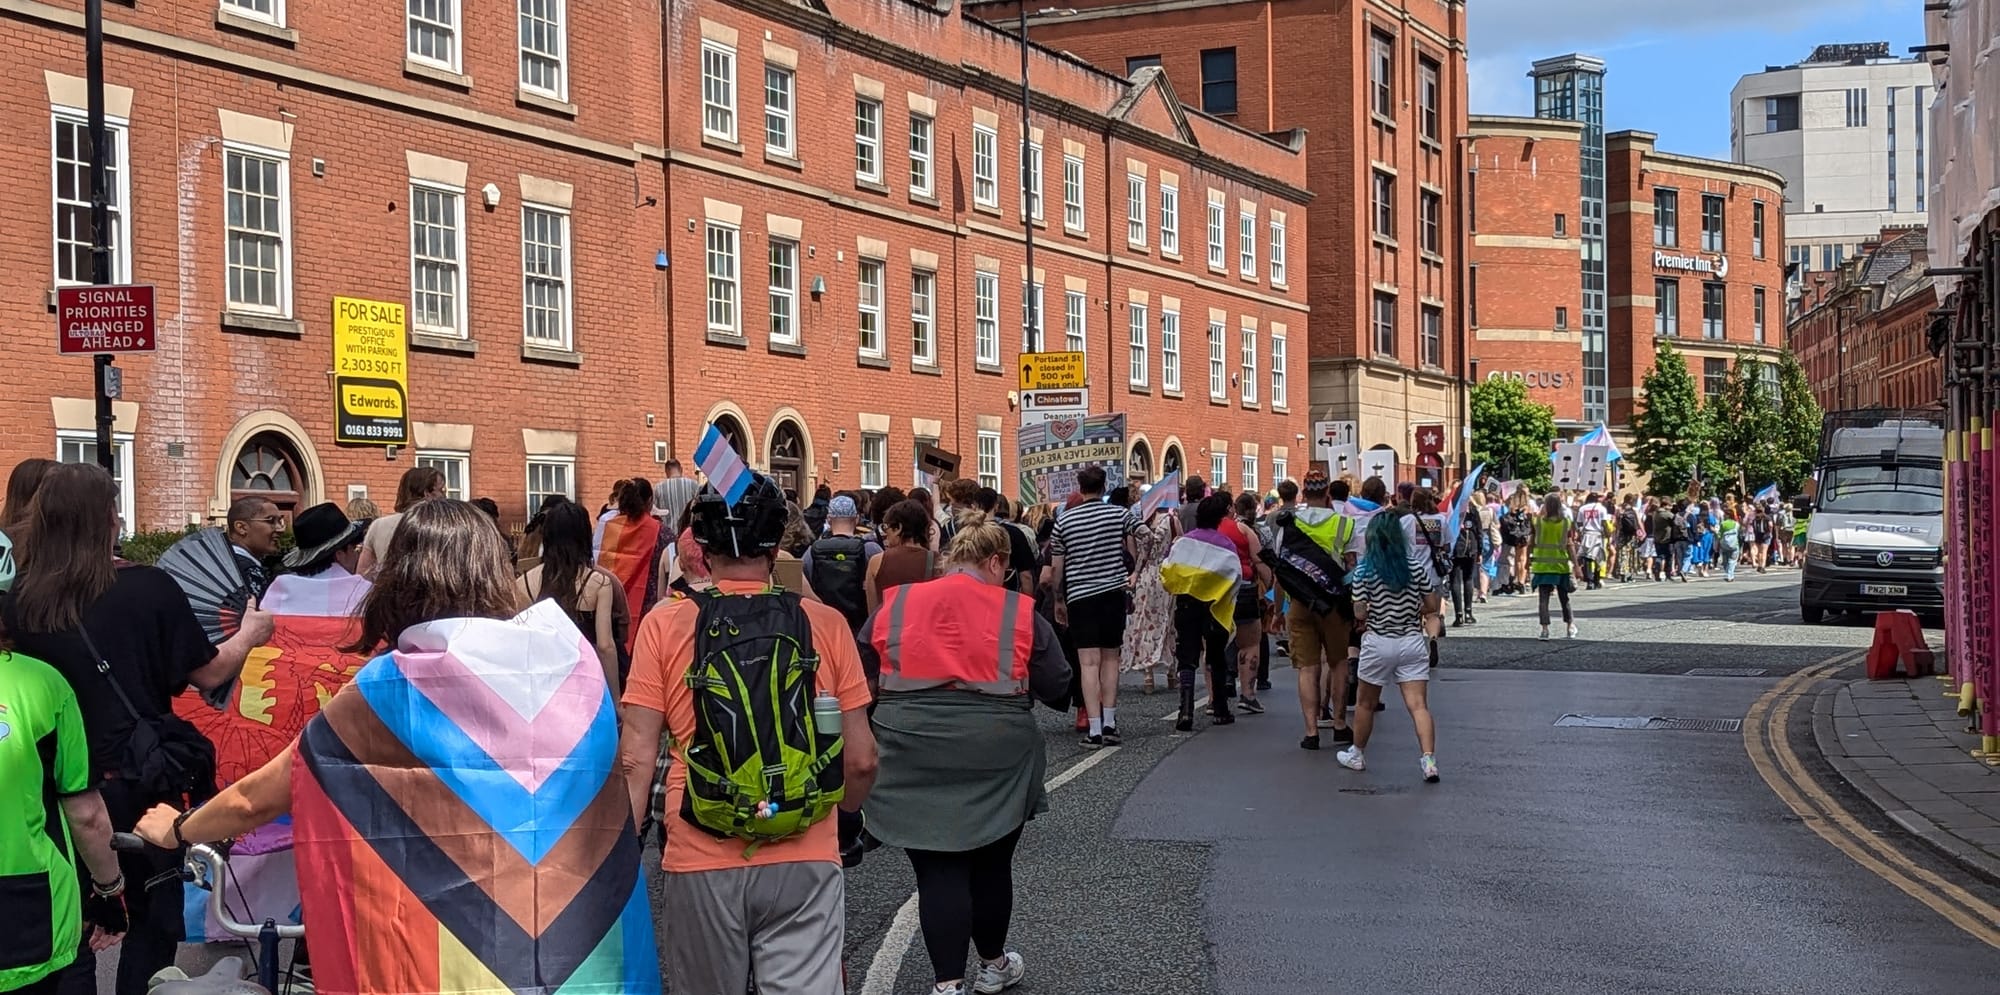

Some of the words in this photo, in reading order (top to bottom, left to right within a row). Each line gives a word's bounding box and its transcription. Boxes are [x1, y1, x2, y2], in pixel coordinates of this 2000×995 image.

[1655, 251, 1694, 270] Premier
[1695, 256, 1711, 272] Inn
[78, 290, 134, 304] SIGNAL
[65, 305, 148, 319] PRIORITIES
[340, 302, 368, 321] FOR
[370, 305, 402, 325] SALE
[69, 320, 144, 333] CHANGED
[348, 325, 395, 338] PRESTIGIOUS
[82, 336, 133, 349] AHEAD
[360, 335, 385, 346] OFFICE
[345, 344, 366, 354] WITH
[368, 346, 398, 357] PARKING
[341, 357, 372, 372] 2,303
[375, 360, 389, 374] SQ
[391, 361, 402, 374] FT
[1060, 374, 1075, 382] yds
[350, 394, 398, 409] Edwards.
[1037, 395, 1080, 404] Chinatown
[345, 424, 365, 436] 0161
[366, 425, 382, 436] 833
[382, 427, 403, 438] 9991
[1855, 525, 1921, 533] POLICE
